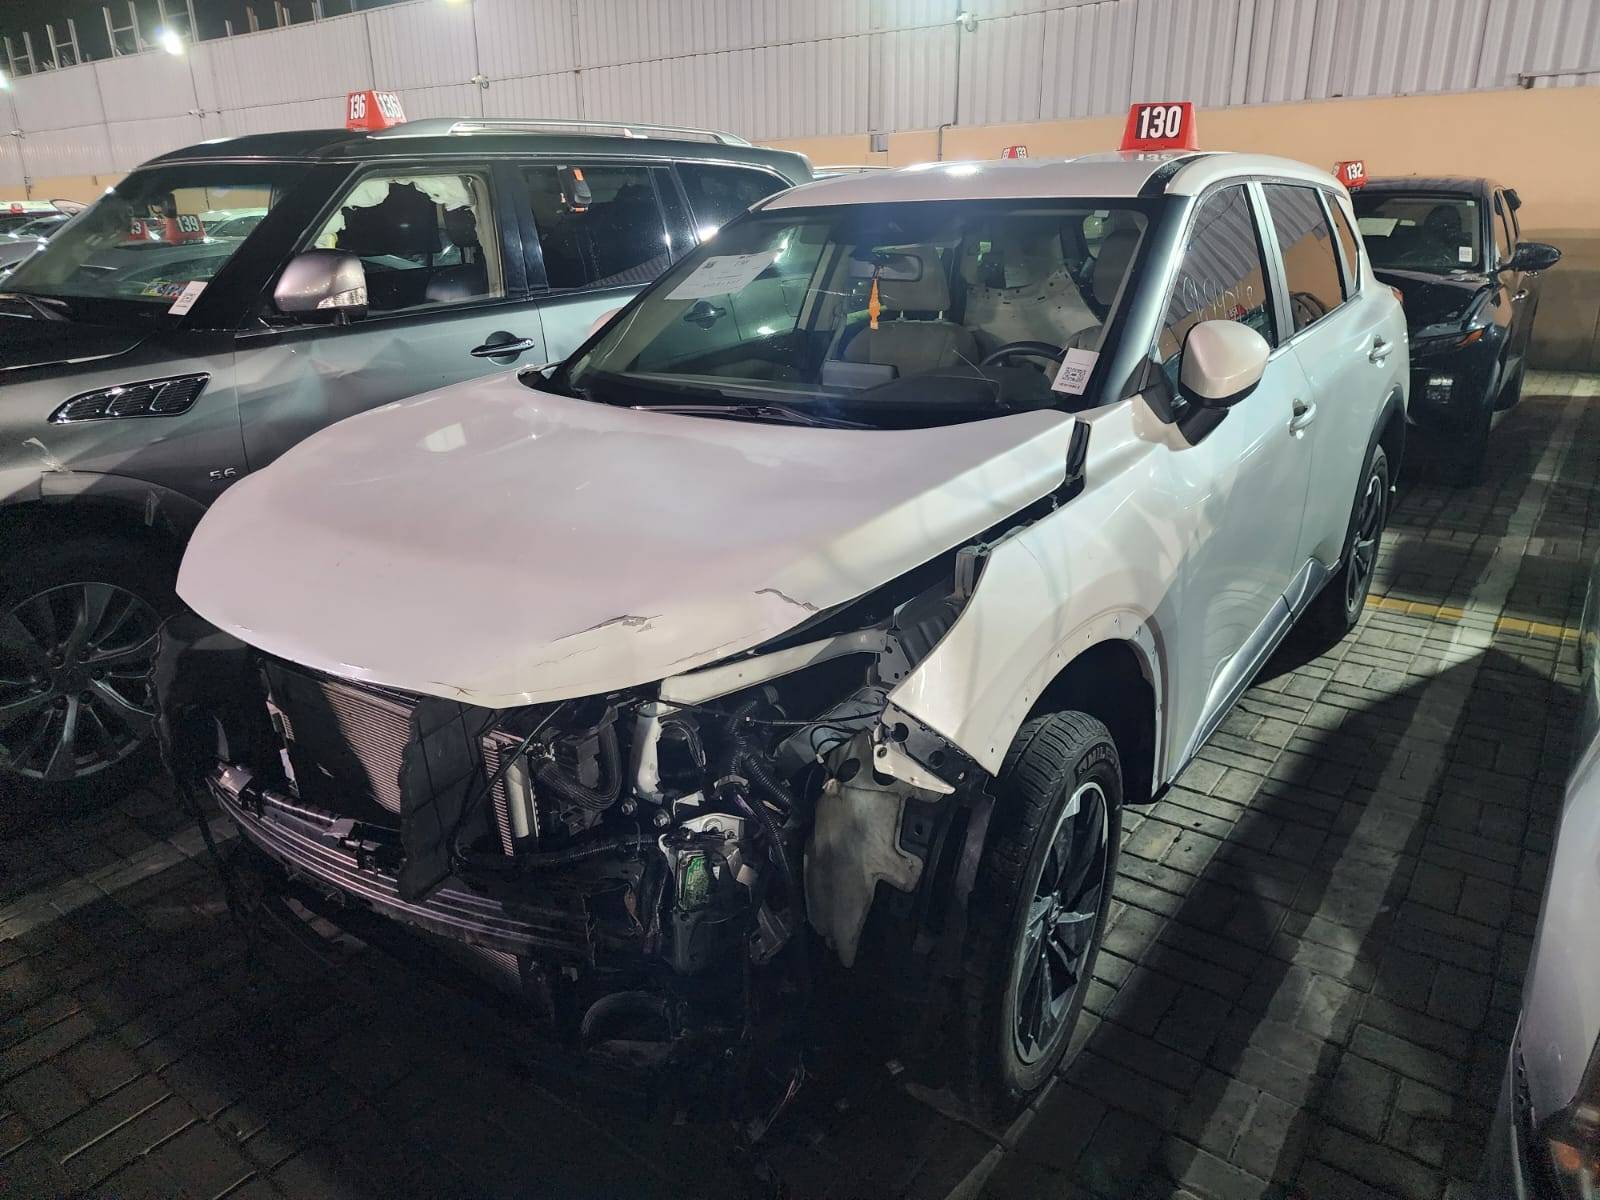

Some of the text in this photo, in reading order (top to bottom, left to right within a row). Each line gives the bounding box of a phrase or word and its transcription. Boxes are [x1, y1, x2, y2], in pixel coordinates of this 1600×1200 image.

[350, 94, 366, 119] 136
[1140, 105, 1182, 139] 130
[1346, 163, 1364, 180] 132
[176, 215, 200, 232] 139
